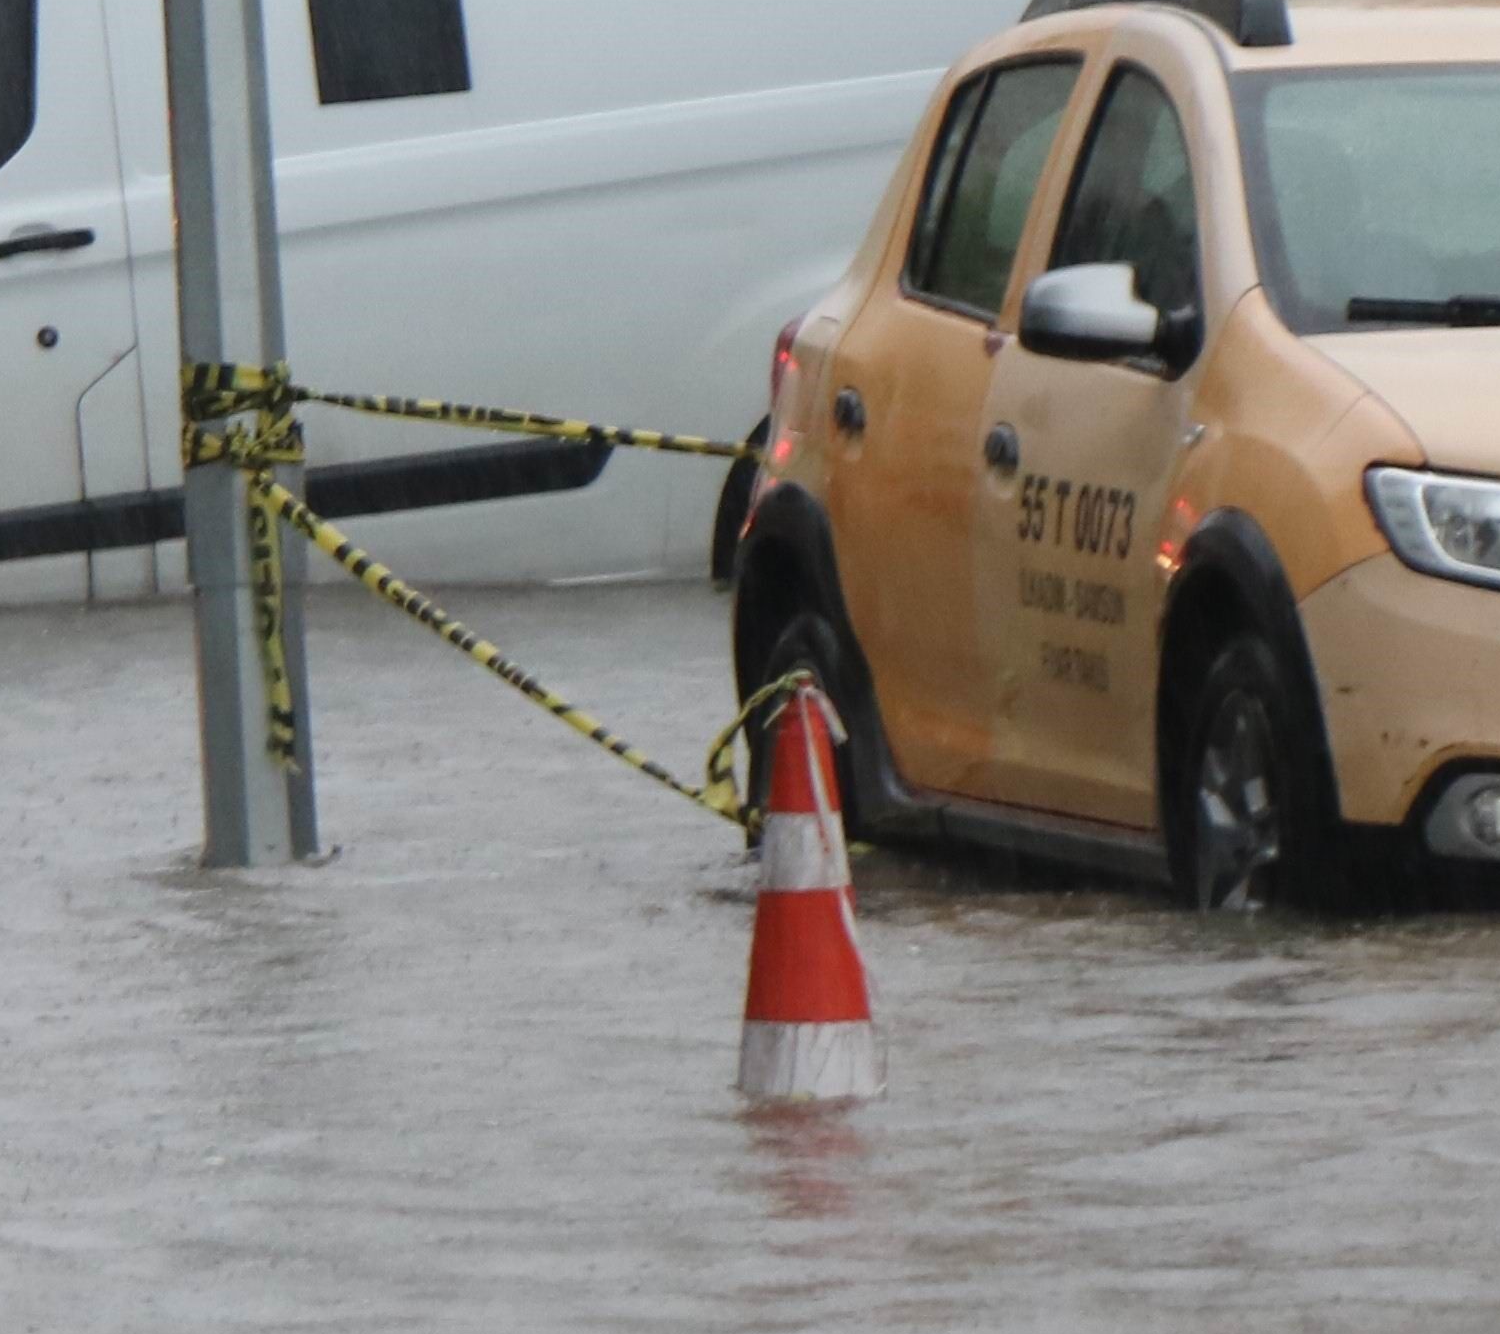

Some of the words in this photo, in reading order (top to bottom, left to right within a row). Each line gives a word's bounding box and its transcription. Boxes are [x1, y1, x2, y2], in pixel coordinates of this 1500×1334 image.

[1017, 474, 1050, 543] 55
[1054, 479, 1072, 546] T
[1073, 481, 1136, 560] 0073
